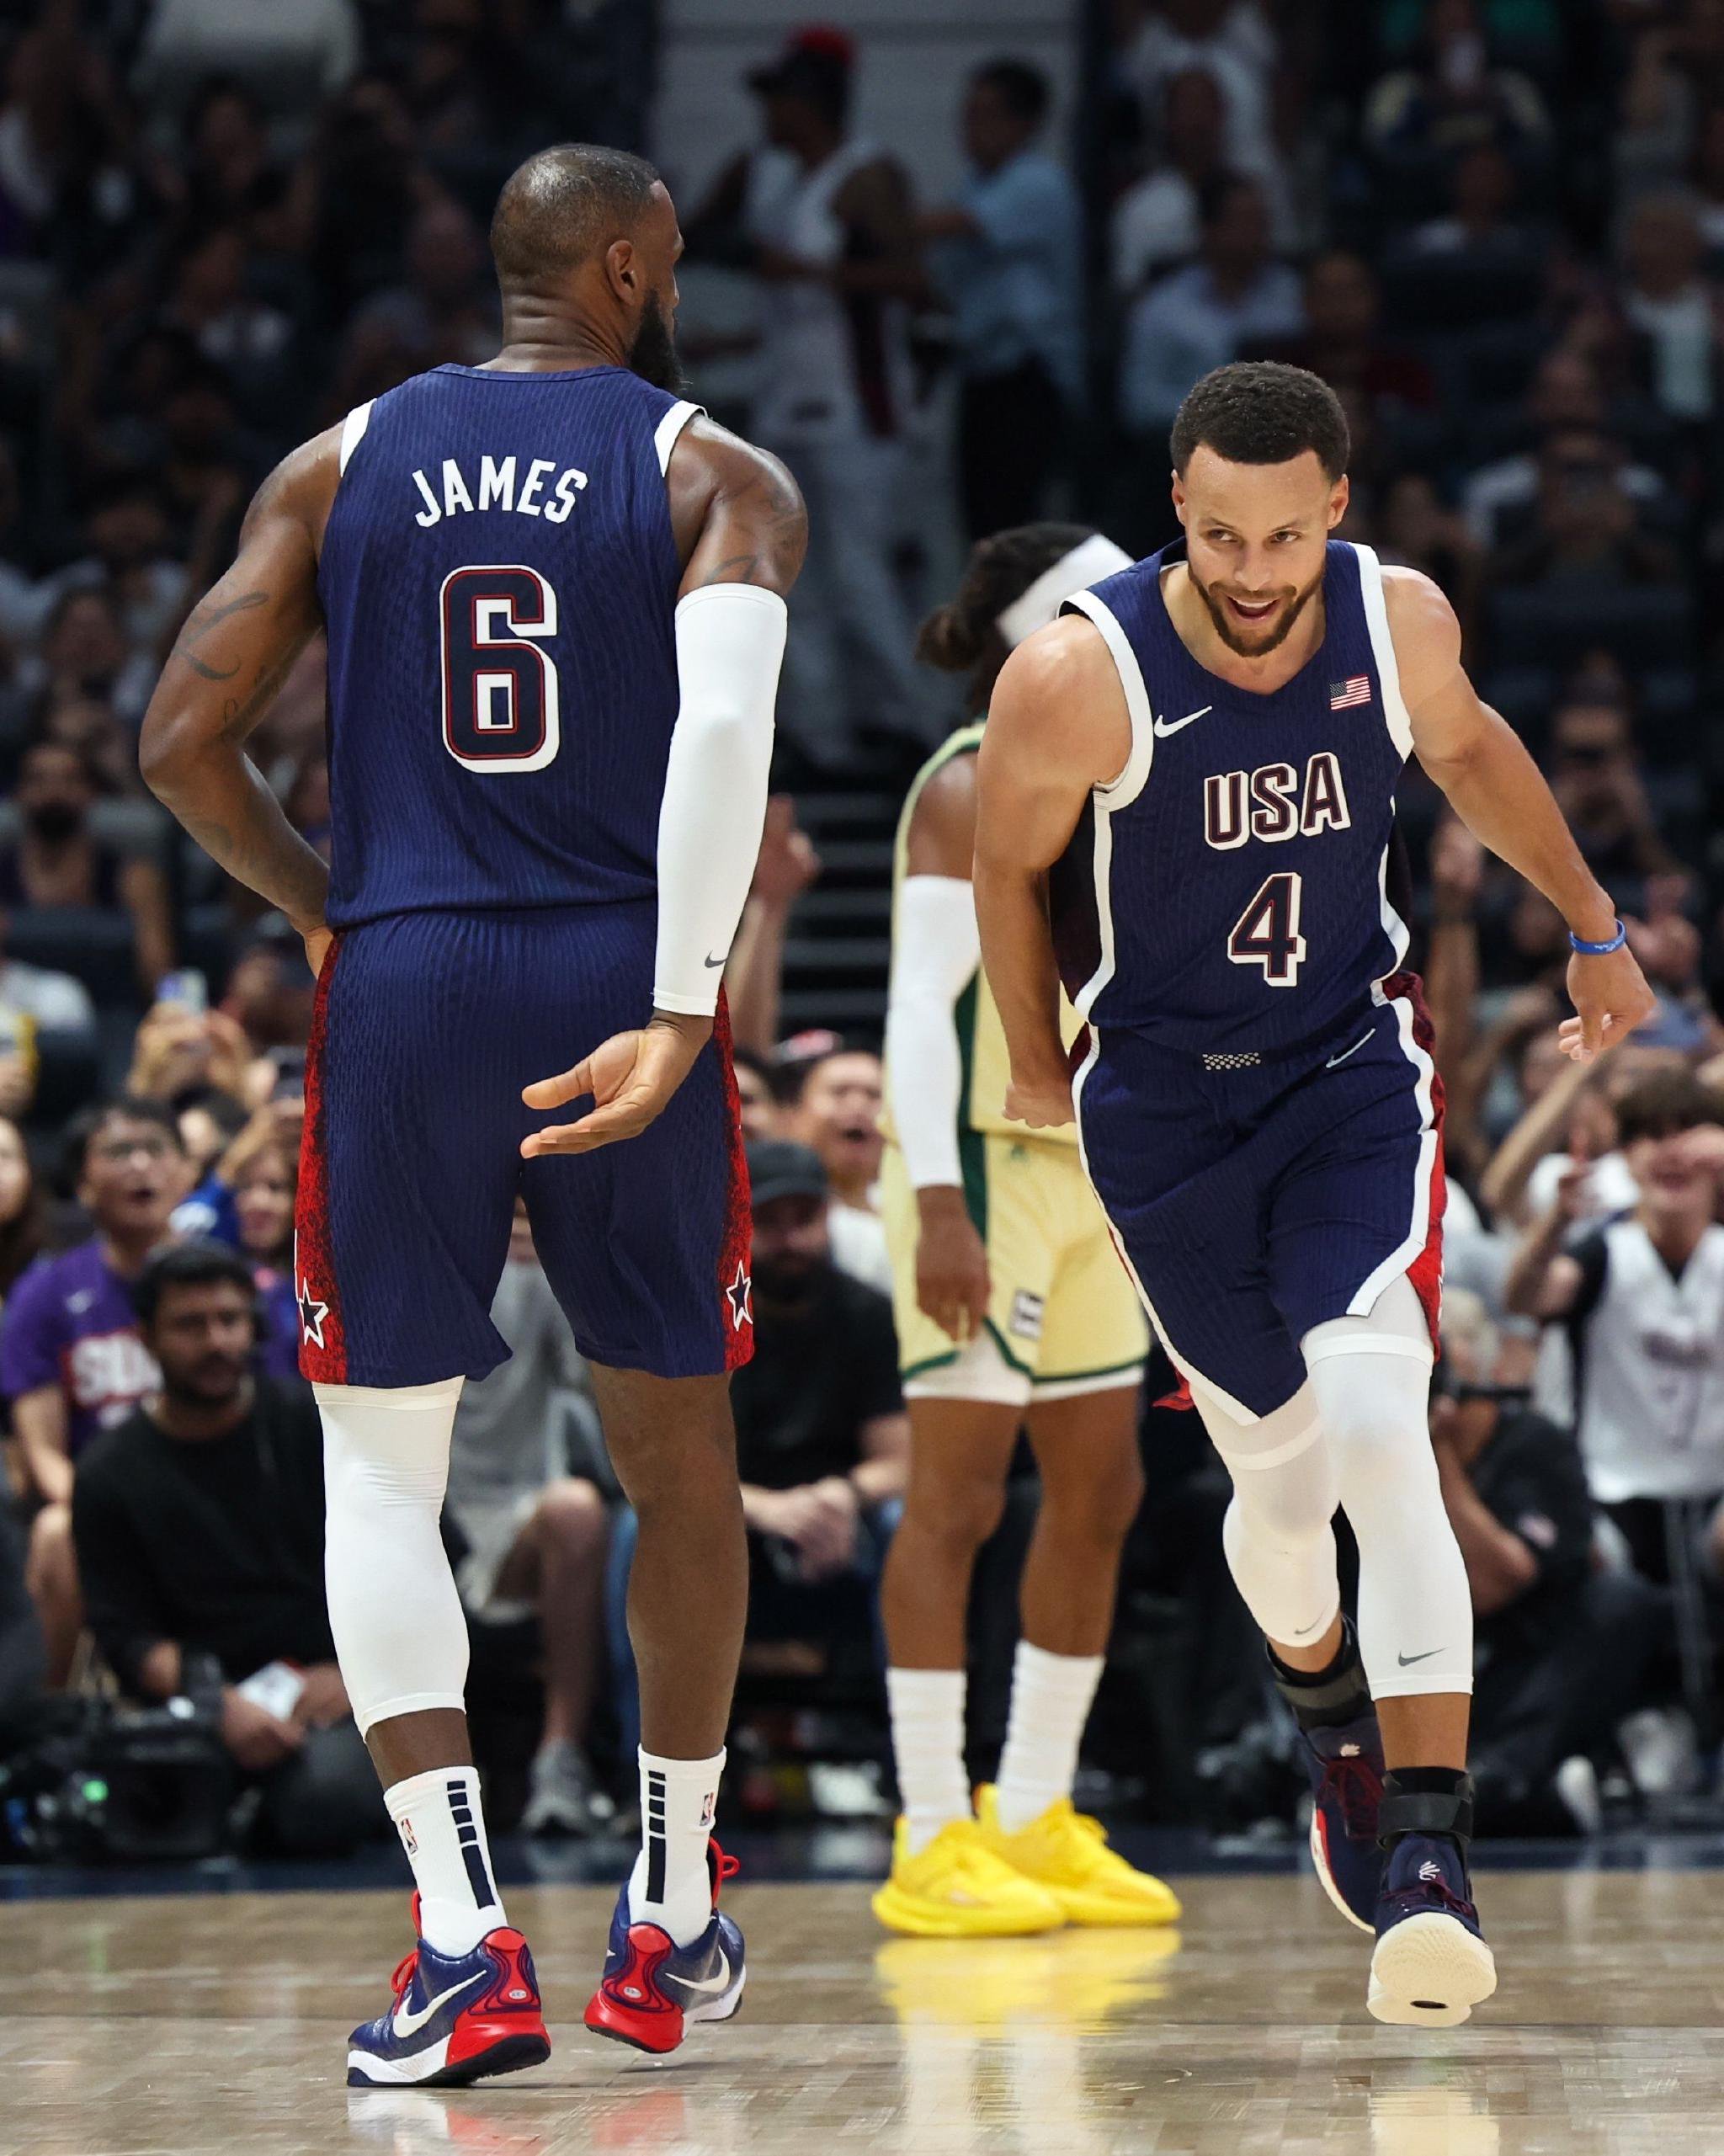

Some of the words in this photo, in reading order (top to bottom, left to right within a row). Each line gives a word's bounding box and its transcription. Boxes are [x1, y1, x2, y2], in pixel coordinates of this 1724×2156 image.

[412, 455, 588, 527] JAMES
[439, 565, 560, 773] 6
[1204, 752, 1351, 850] USA
[1227, 872, 1306, 987] 4
